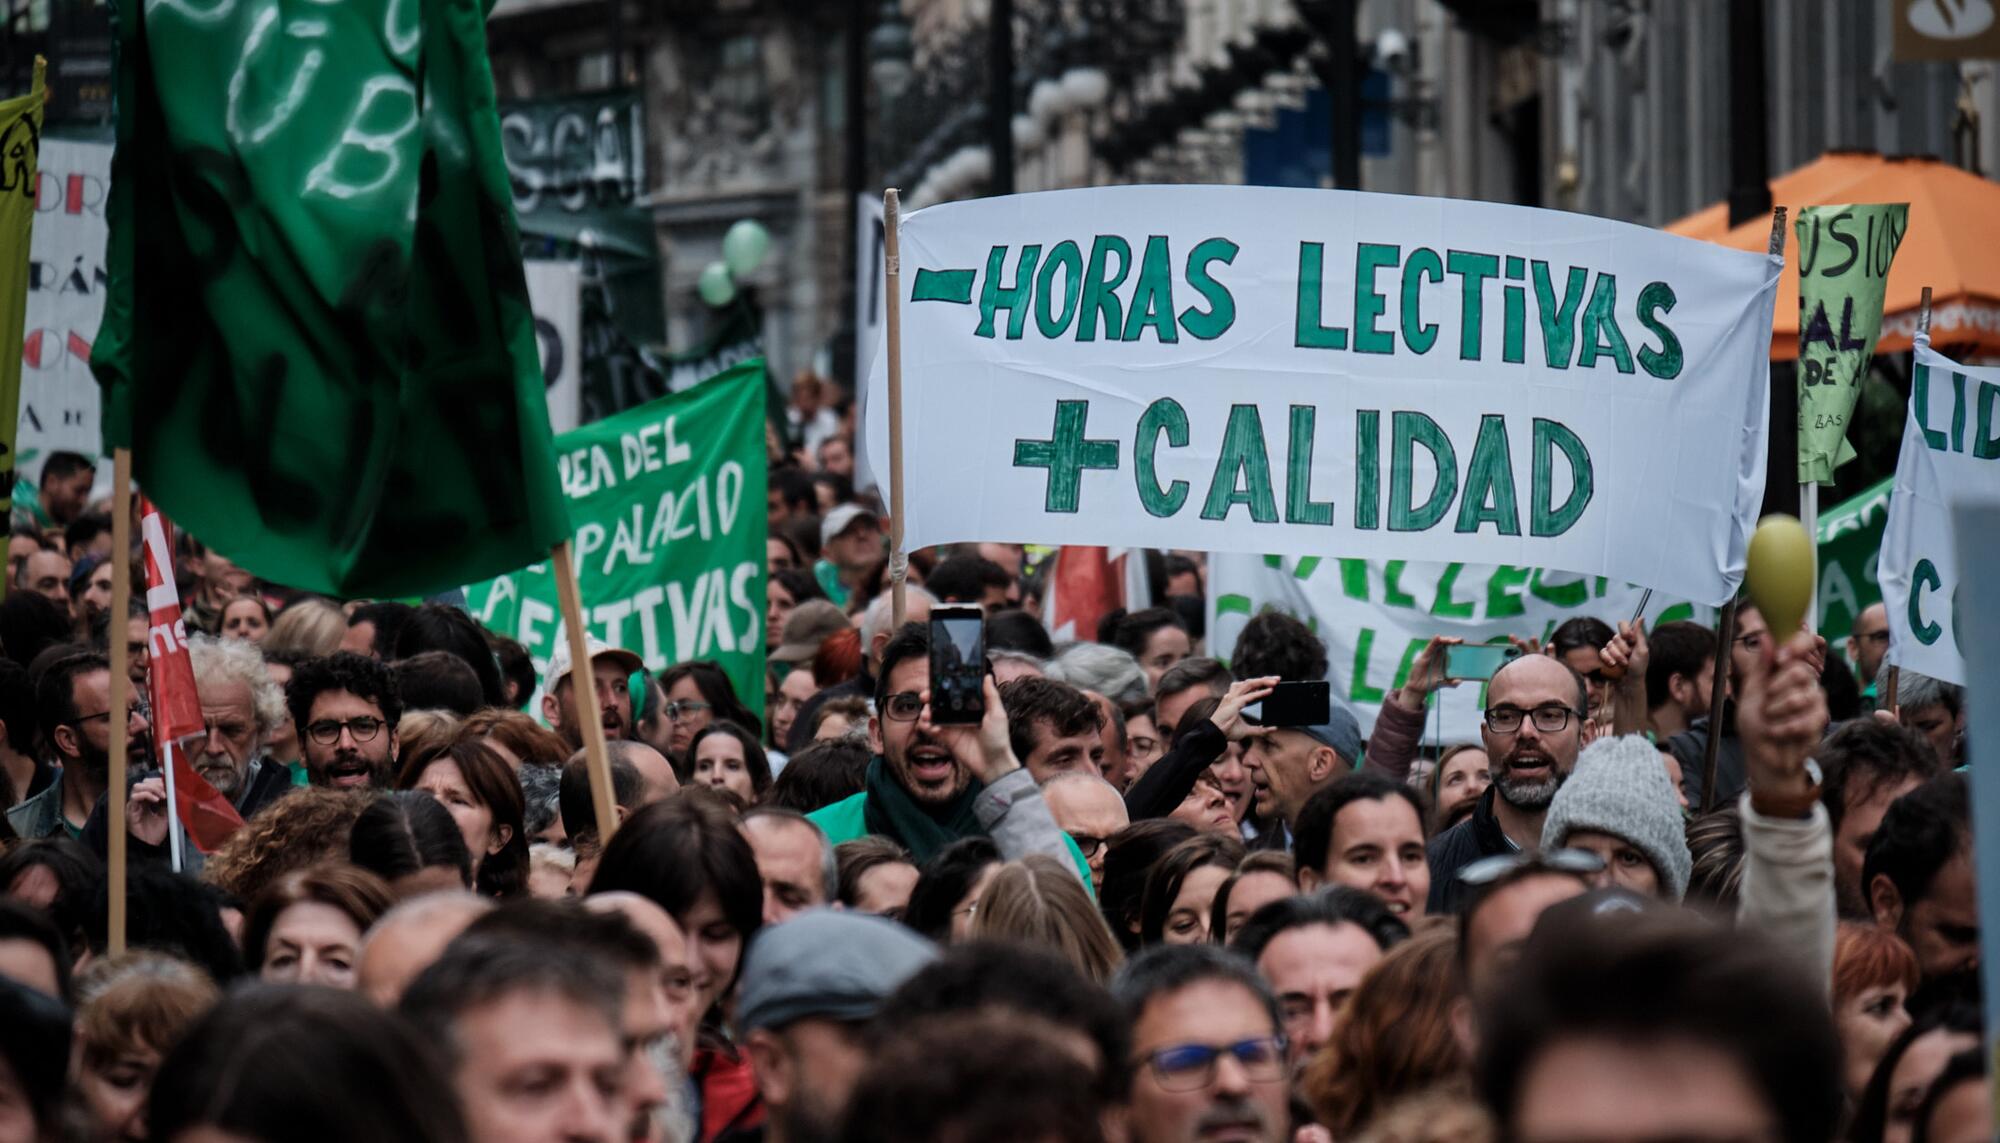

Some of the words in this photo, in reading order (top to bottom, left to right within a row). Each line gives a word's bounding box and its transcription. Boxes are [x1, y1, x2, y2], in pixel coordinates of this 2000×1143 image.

[1799, 296, 1866, 352] AL
[1804, 356, 1837, 387] DE
[620, 415, 691, 481] DEL
[573, 460, 744, 580] PALACIO
[517, 563, 759, 678] ETIVAS
